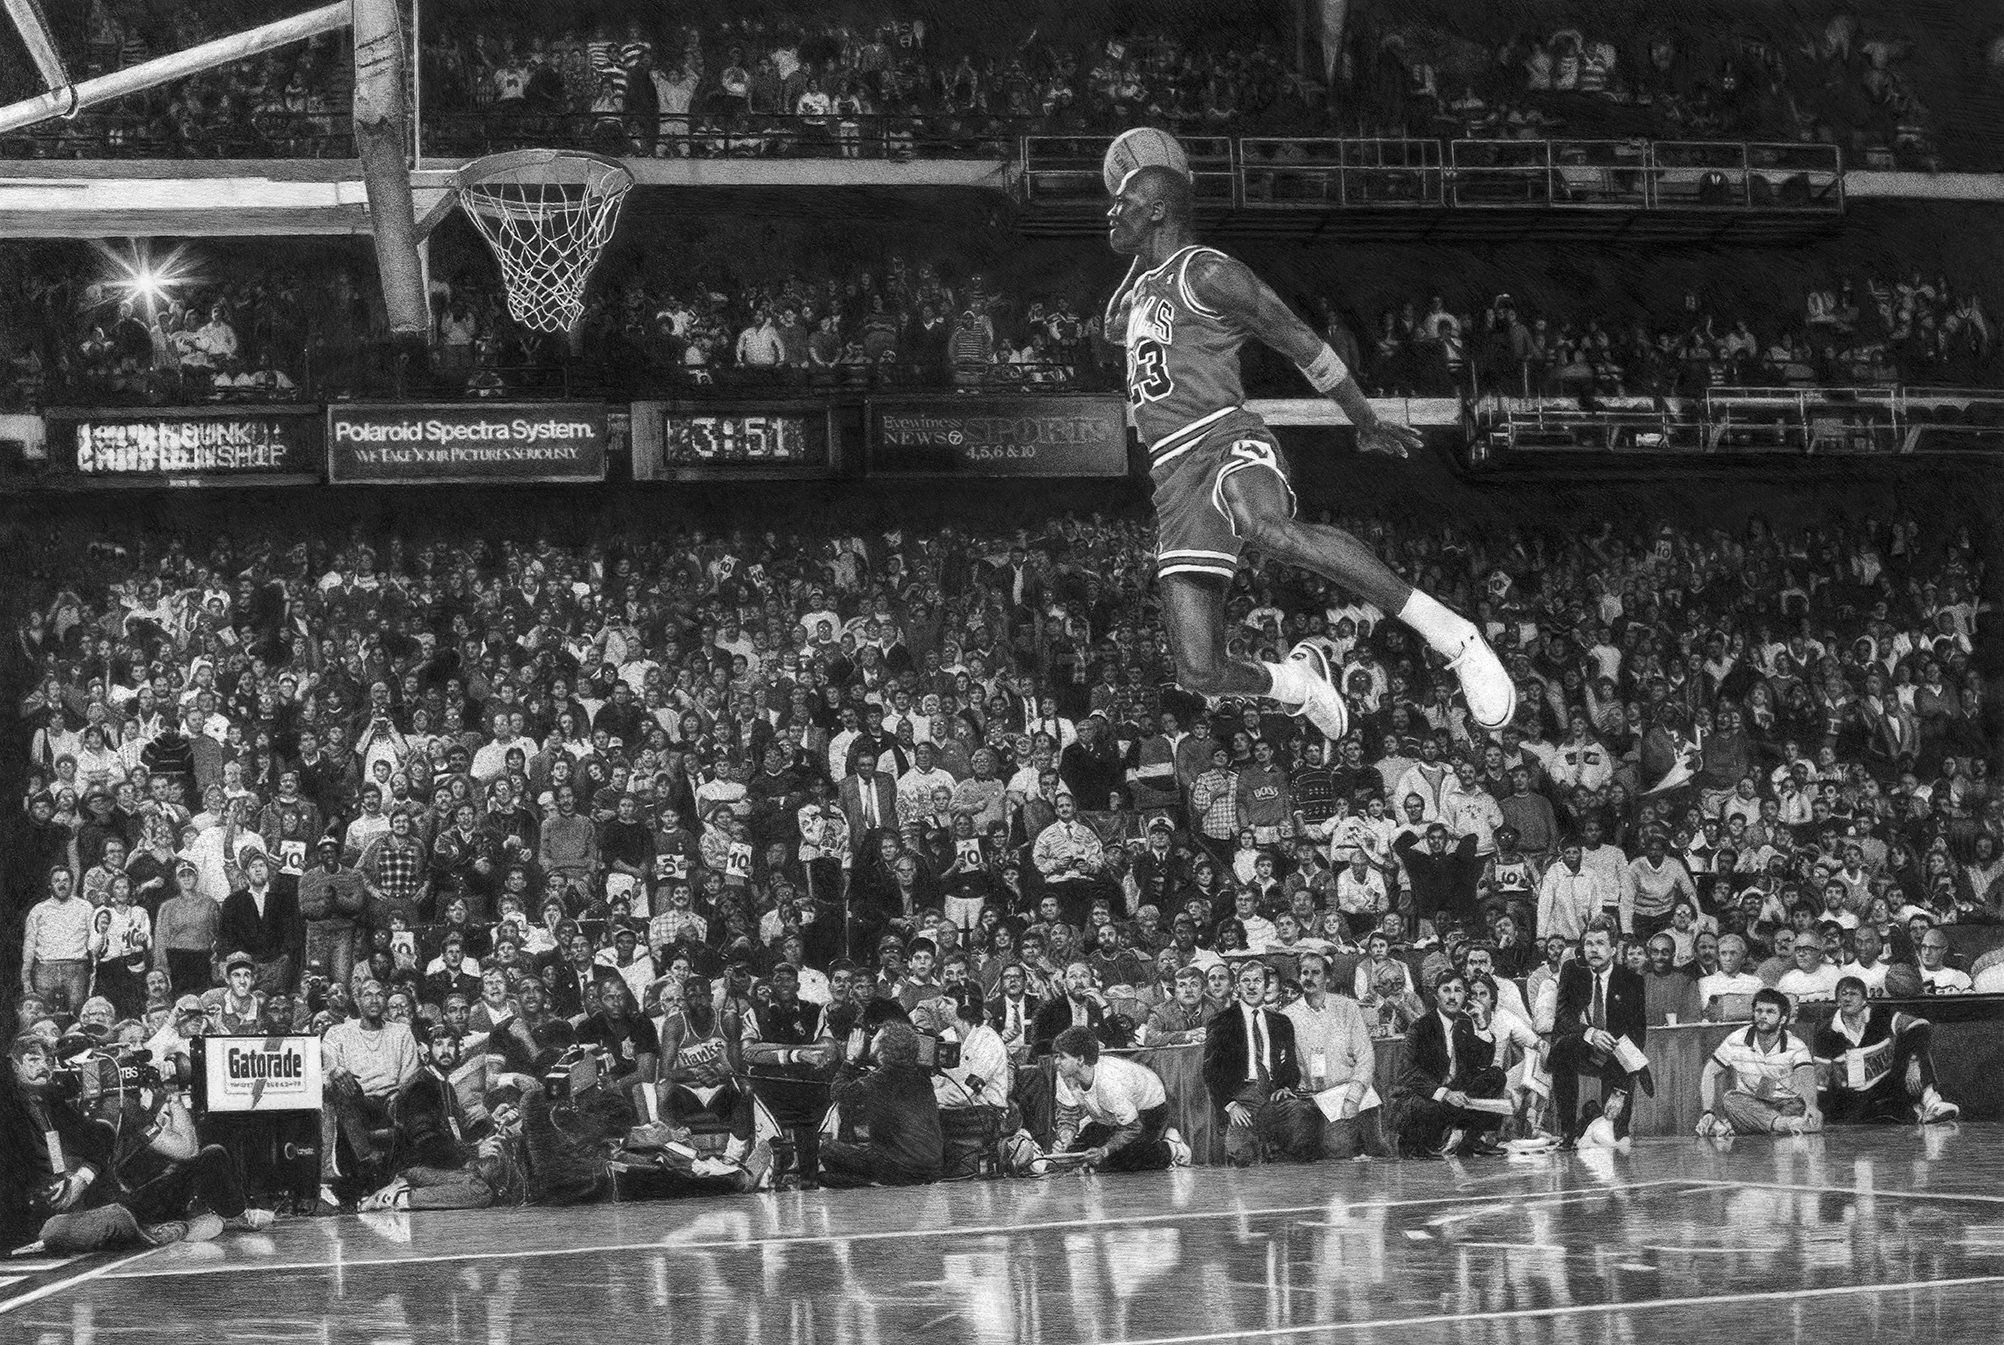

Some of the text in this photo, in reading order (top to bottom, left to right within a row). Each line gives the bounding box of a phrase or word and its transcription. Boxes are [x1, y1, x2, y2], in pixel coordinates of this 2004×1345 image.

[335, 421, 423, 442] Polaroid
[425, 420, 510, 444] Spectra
[511, 419, 596, 443] System.
[692, 417, 789, 457] 3:51
[883, 431, 948, 445] NEWS
[729, 852, 750, 869] 10
[120, 1066, 138, 1079] TBS
[228, 1047, 302, 1079] Gatorade
